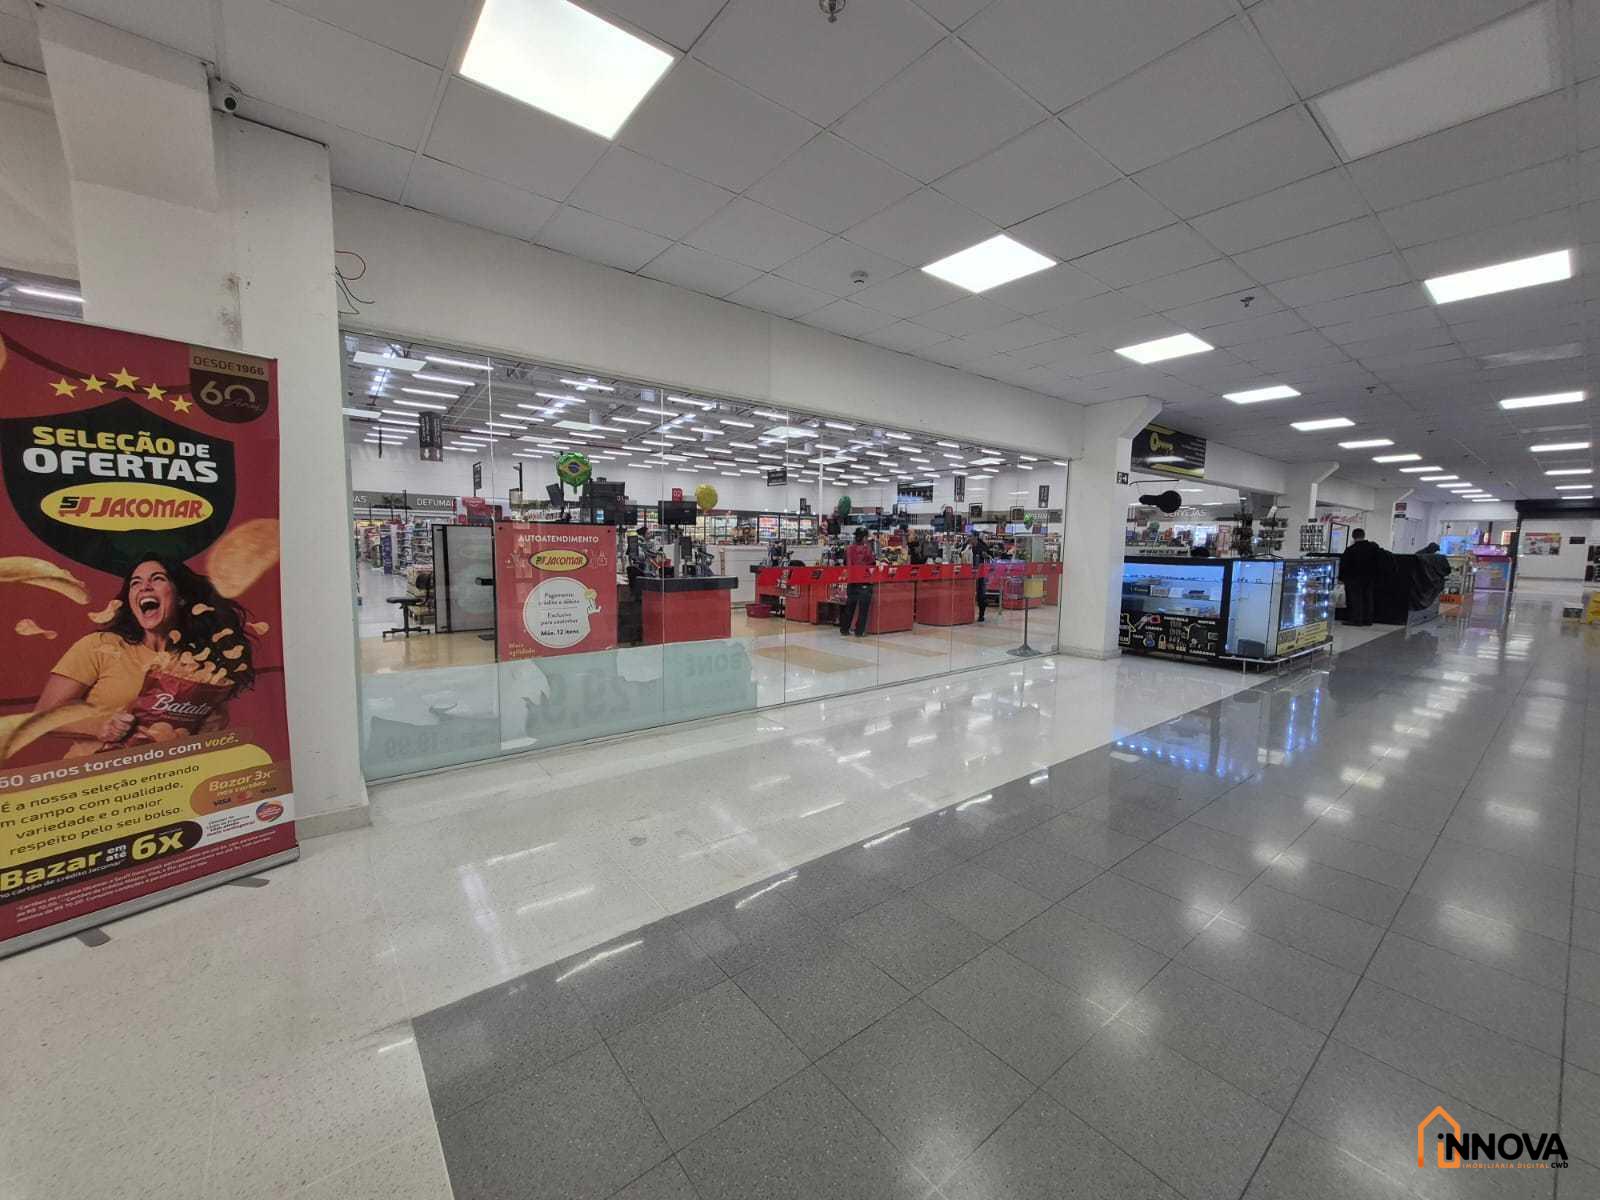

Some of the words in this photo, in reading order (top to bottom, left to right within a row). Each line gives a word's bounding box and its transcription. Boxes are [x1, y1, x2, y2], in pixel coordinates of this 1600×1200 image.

[32, 425, 175, 456] SELEÇÃO
[179, 442, 209, 458] DE
[22, 447, 218, 484] OFERTAS
[91, 498, 203, 519] JACOMAR
[672, 488, 682, 497] 02
[518, 534, 599, 544] AUTOATENDIMENTO
[30, 765, 80, 784] anos
[84, 749, 164, 773] torcendo
[168, 741, 201, 756] com
[1, 801, 13, 813] É
[15, 803, 25, 811] a
[30, 791, 78, 808] nossa
[81, 777, 138, 797] seleção
[140, 764, 200, 785] entrando
[208, 774, 252, 793] Bazar
[16, 814, 95, 840] variedade
[98, 811, 108, 820] e
[111, 808, 120, 817] o
[123, 799, 162, 814] maior
[20, 804, 75, 825] campo
[79, 798, 110, 811] com
[114, 782, 184, 804] qualidade.
[9, 831, 77, 856] respeito
[81, 821, 113, 839] pelo
[116, 816, 141, 829] seu
[105, 851, 127, 862] até
[131, 831, 184, 861] 6x
[0, 851, 104, 892] Bazar
[106, 844, 127, 854] em
